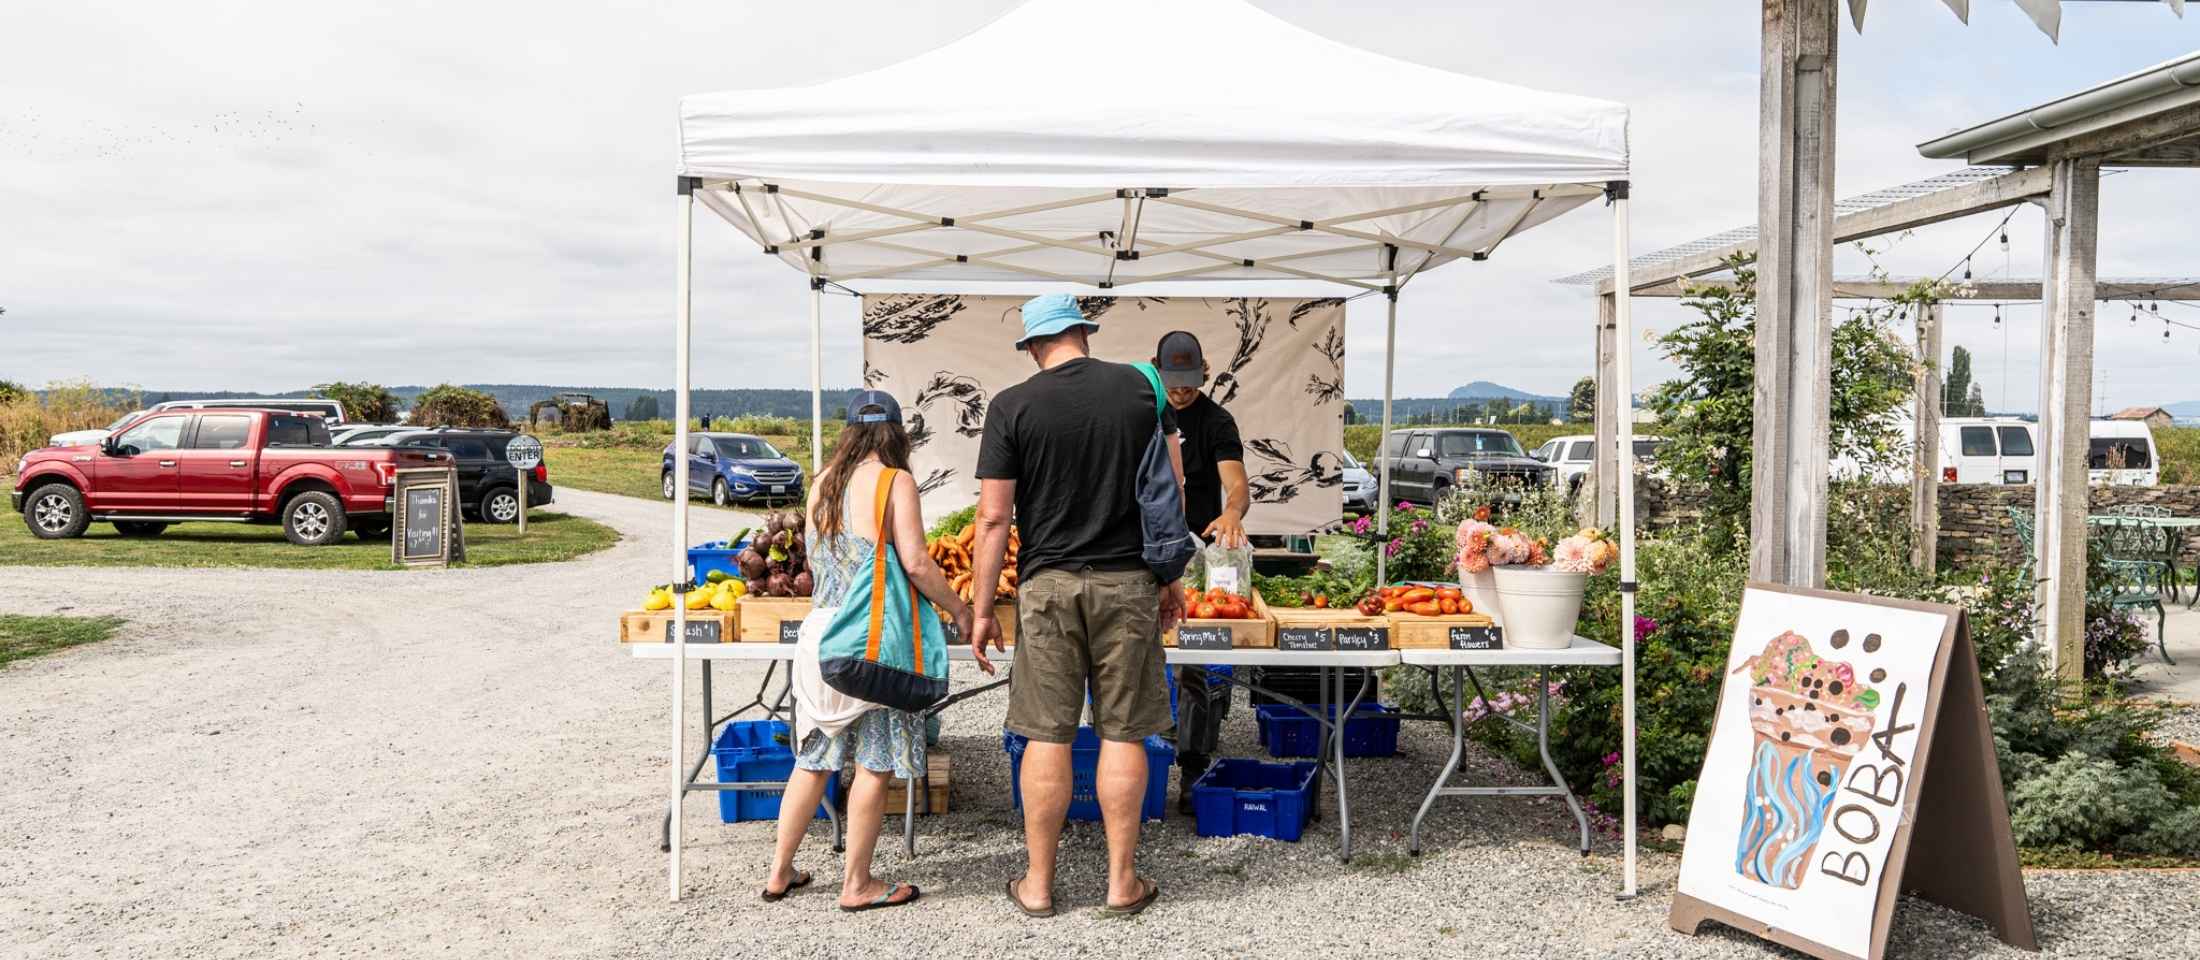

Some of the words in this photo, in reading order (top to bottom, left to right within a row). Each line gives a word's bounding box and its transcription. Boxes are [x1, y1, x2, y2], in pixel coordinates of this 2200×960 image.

[509, 448, 540, 461] ENTER
[411, 495, 437, 505] Thanks
[670, 624, 703, 637] Sash
[1180, 630, 1203, 646] Spring
[1338, 633, 1368, 649] Parsley
[1369, 631, 1380, 645] $3
[1821, 682, 1915, 887] BOBA
